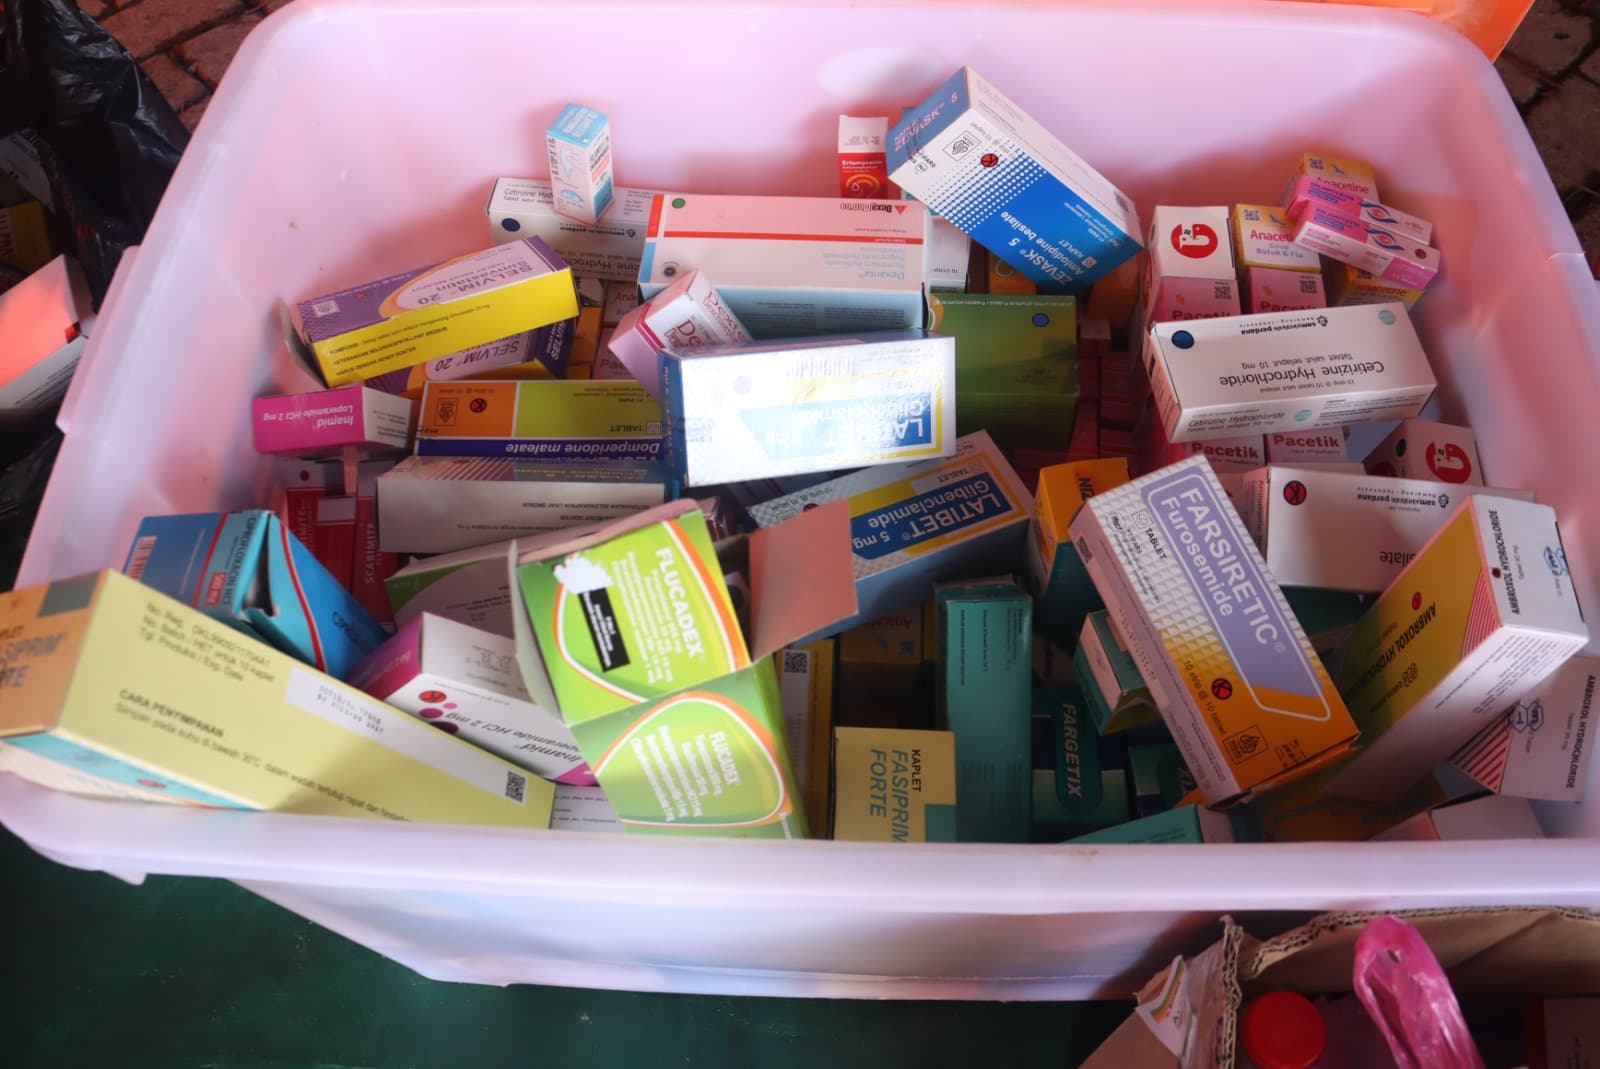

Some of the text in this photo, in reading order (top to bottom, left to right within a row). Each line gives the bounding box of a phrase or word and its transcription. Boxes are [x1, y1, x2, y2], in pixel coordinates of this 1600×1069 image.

[1000, 211, 1085, 275] Amlodipine besilate
[1008, 237, 1073, 284] ZEVASK 5
[418, 293, 441, 305] 20
[435, 358, 453, 373] 20
[463, 340, 520, 366] SELVIM
[1219, 361, 1384, 388] Cetirizine Hydrochloride
[1241, 362, 1256, 370] mg
[1259, 360, 1269, 368] 10
[505, 441, 660, 455] Domperidone maleate
[1191, 441, 1260, 460] Pacetik
[1273, 434, 1340, 448] Pacetik
[867, 480, 990, 529] Glibenclamide
[907, 492, 1001, 540] LATIBET
[852, 531, 890, 550] 5 mg
[1145, 527, 1168, 560] TABLET
[1160, 496, 1234, 617] Furosemide
[1488, 508, 1521, 616] AMBROXOL HYDROCHLORIDE
[1179, 487, 1278, 646] FARSIRETIC
[656, 547, 705, 662] FLUCADEX
[1395, 601, 1437, 653] AMBROXOL
[911, 749, 922, 792] KAPLET
[1062, 702, 1082, 798] FARGETIX
[869, 748, 888, 818] FORTE
